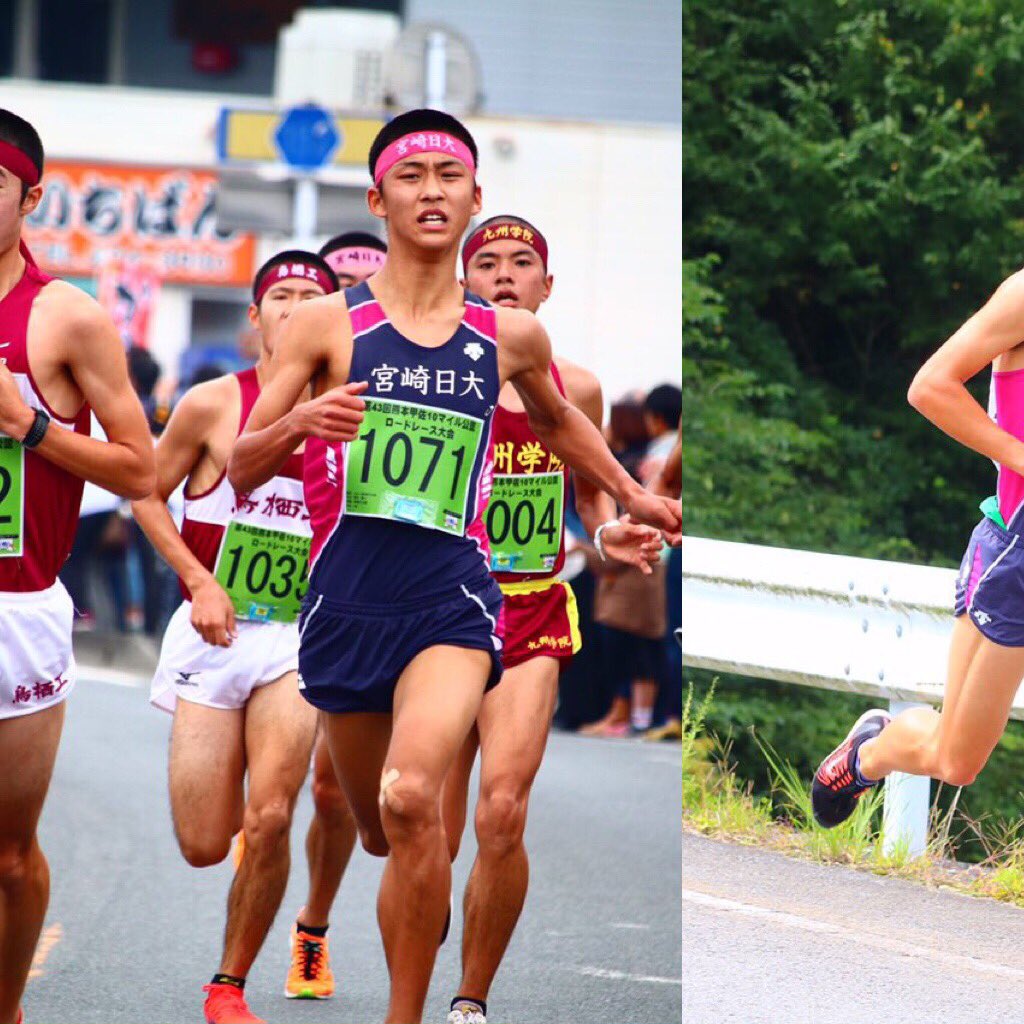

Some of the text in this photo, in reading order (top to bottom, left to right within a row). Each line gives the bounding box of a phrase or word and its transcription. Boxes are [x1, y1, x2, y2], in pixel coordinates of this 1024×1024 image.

[482, 226, 534, 244] 九州学院
[371, 363, 484, 400] 宮崎日大
[358, 428, 467, 501] 1071
